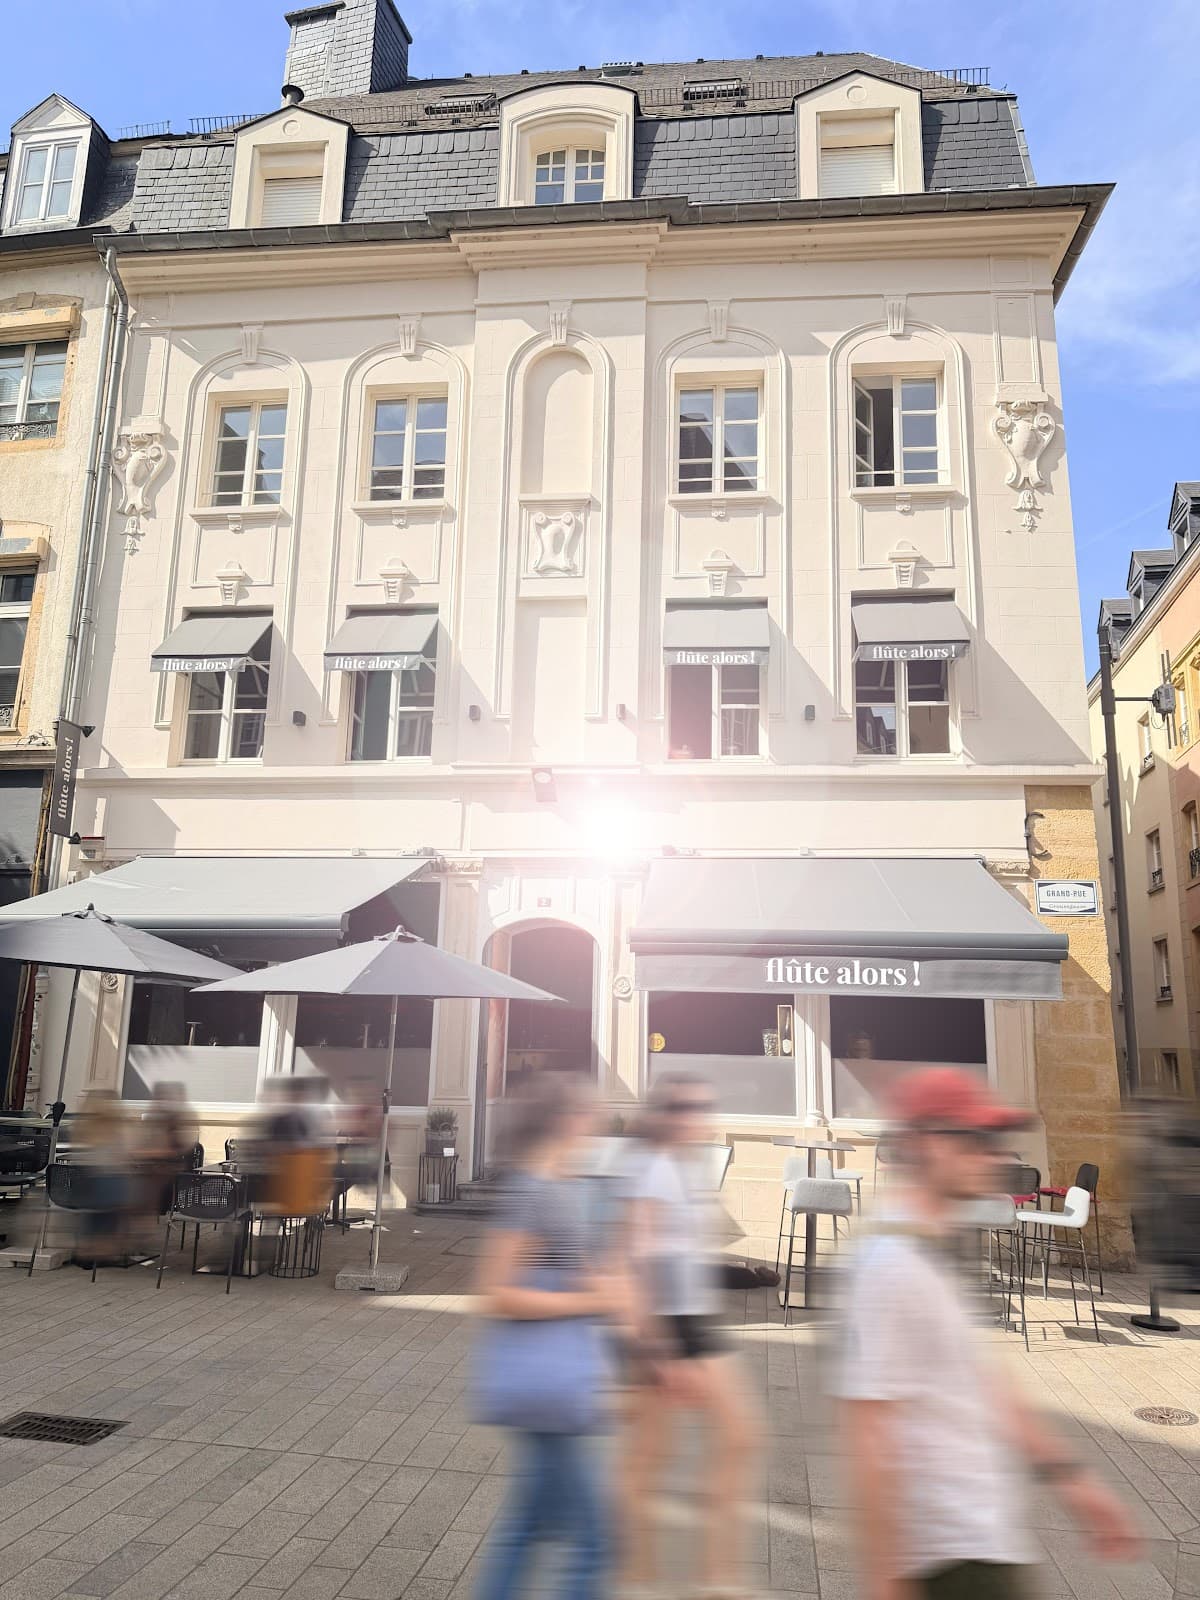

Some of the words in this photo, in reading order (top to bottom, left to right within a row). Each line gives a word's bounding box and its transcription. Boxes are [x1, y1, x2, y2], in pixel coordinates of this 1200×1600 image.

[676, 651, 709, 664] flûte
[872, 645, 907, 659] flûte
[162, 658, 193, 671] flûte
[335, 657, 366, 669] flûte
[765, 957, 829, 984] flûte
